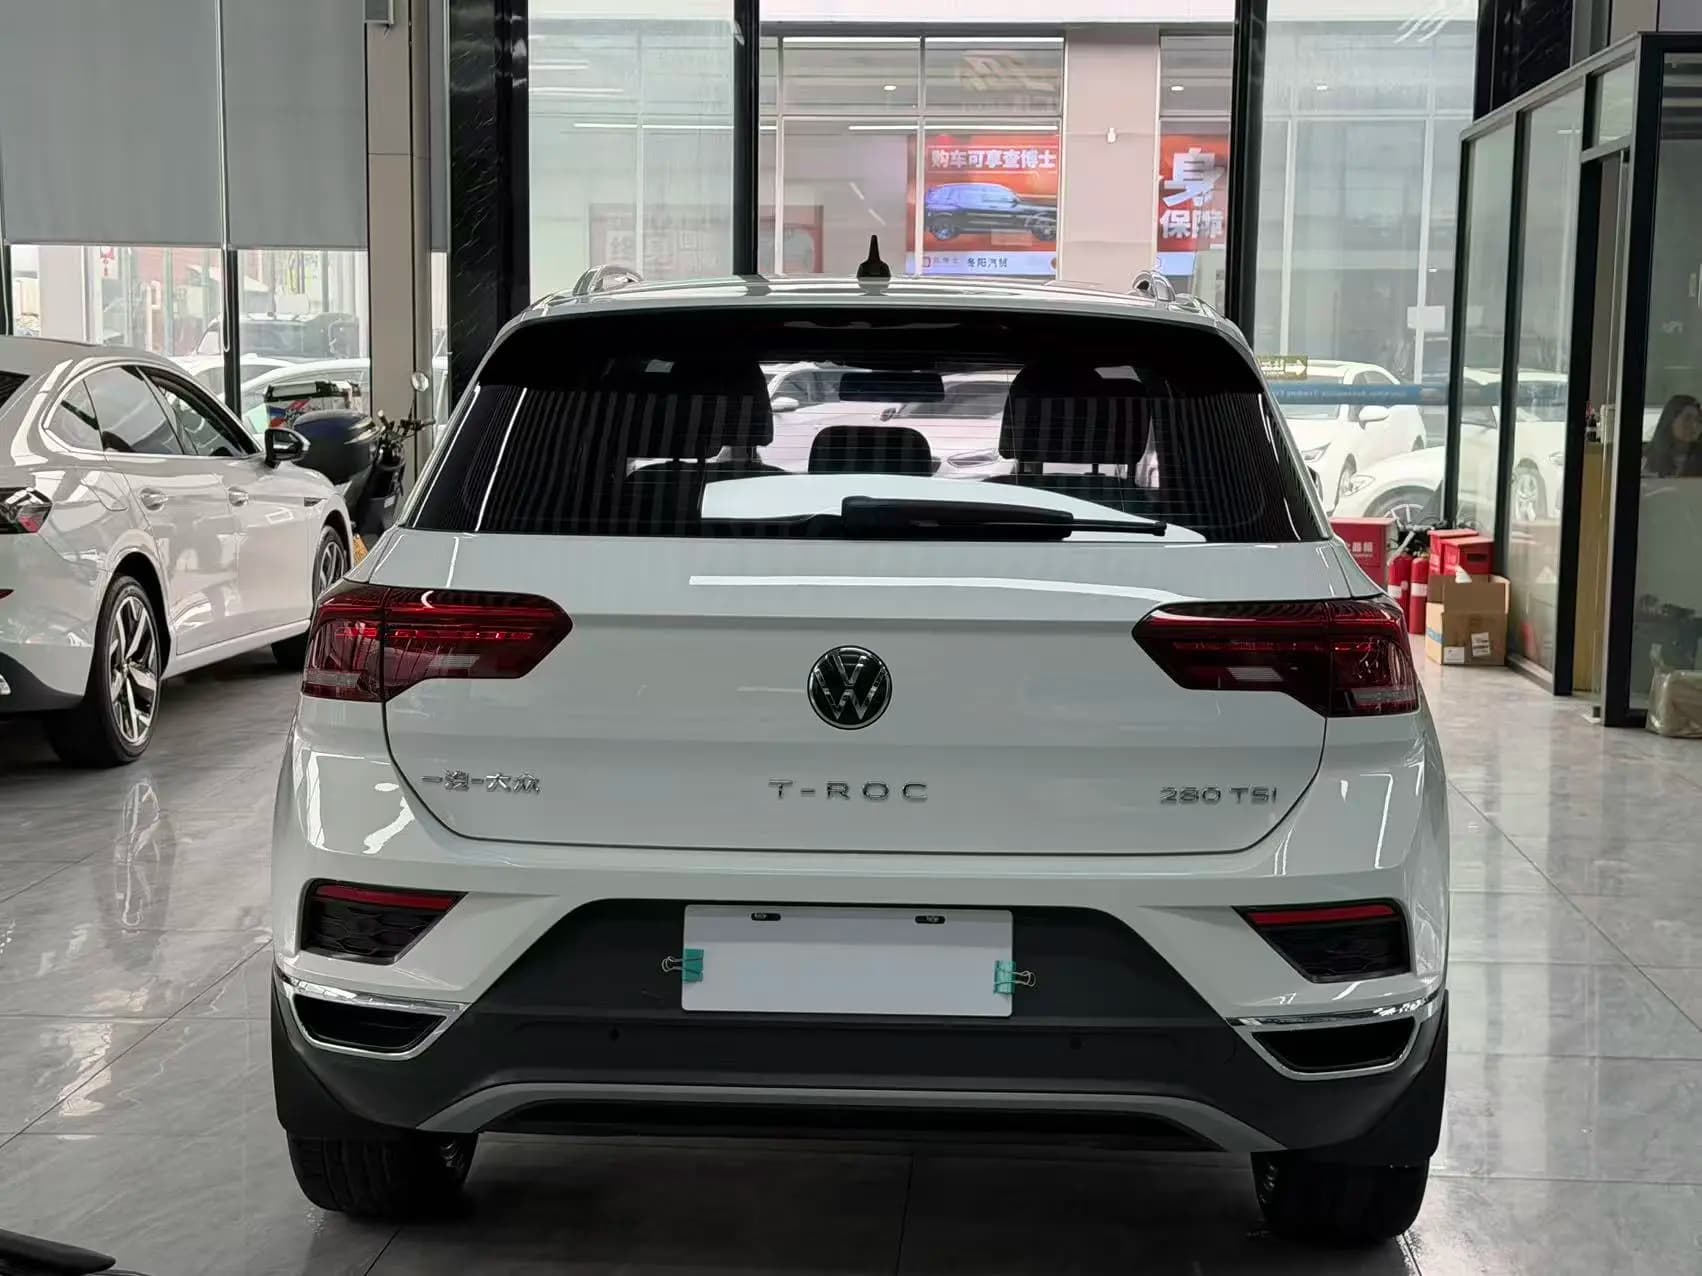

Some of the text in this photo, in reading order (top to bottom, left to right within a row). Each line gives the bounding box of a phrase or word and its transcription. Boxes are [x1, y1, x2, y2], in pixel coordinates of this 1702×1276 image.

[1162, 147, 1224, 206] 身
[768, 778, 928, 801] T-ROC
[1160, 786, 1277, 804] 280 TSI
